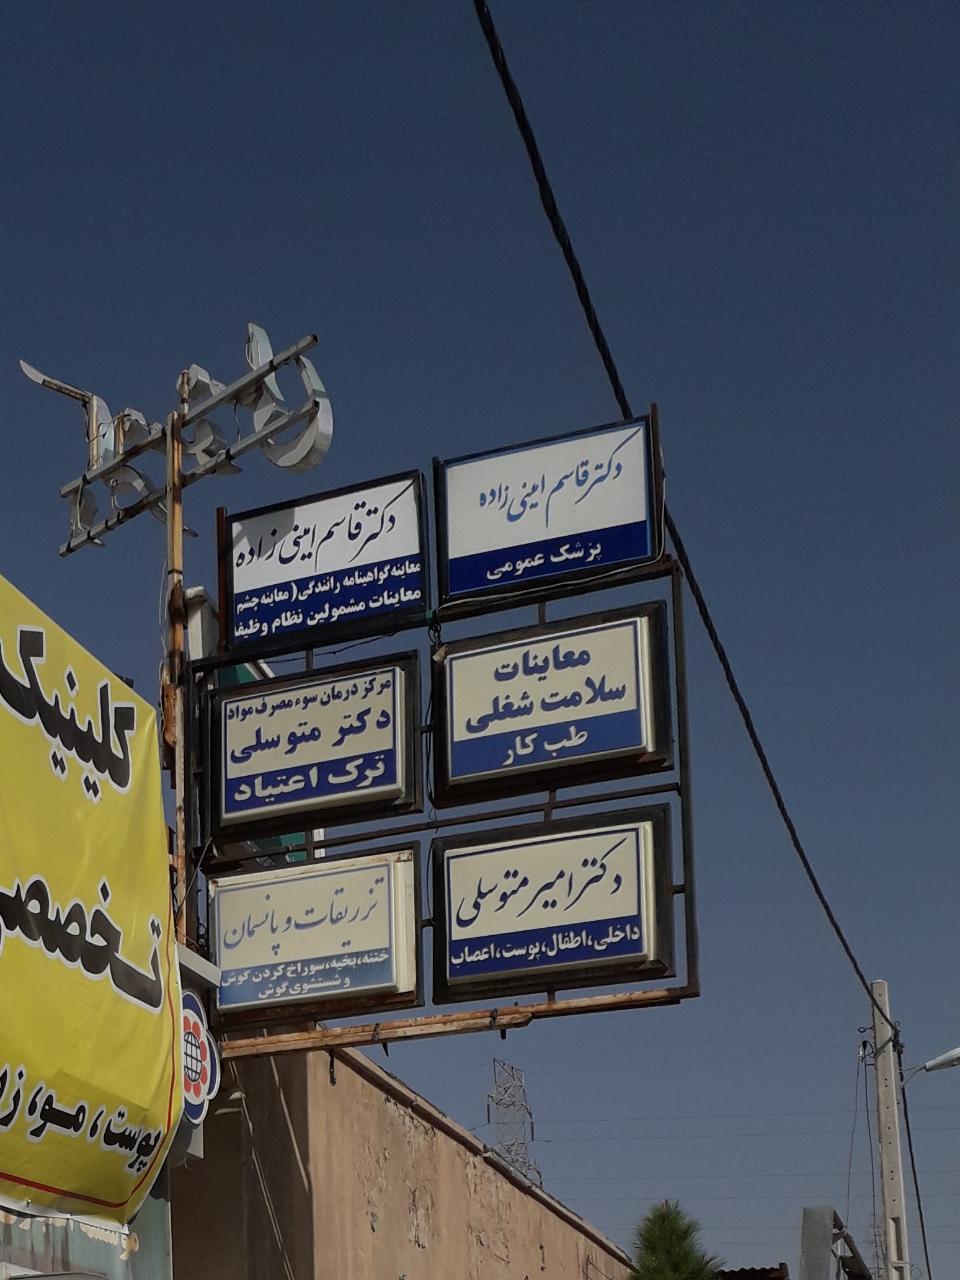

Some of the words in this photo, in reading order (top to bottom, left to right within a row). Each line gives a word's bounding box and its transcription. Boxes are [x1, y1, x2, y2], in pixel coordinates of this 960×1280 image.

[574, 428, 642, 505] دکتر
[479, 482, 510, 510] زاده
[506, 474, 546, 523] امینی
[546, 460, 590, 528] قاسم
[315, 500, 366, 573] قاسم
[349, 478, 418, 563] دکتر
[235, 528, 278, 568] زاده
[278, 522, 317, 565] امینی
[550, 542, 602, 563] پزشک
[342, 565, 391, 592] گواهینامه
[390, 559, 422, 579] معاینه
[486, 552, 545, 580] عمومی
[306, 601, 366, 627] مشمولین
[368, 588, 422, 609] معاینات
[271, 611, 304, 634] نظام
[493, 644, 591, 682] معاینات
[295, 692, 318, 710] سوء
[320, 683, 359, 706] درمان
[362, 677, 392, 696] مرکز
[540, 675, 626, 712] سلامت
[227, 704, 254, 721] مواد
[255, 697, 294, 717] مصرف
[465, 689, 534, 734] شغلی
[230, 721, 322, 764] متوسلی
[332, 707, 391, 747] دکتر
[543, 725, 589, 757] طب
[502, 732, 539, 766] کار
[233, 766, 319, 802] اعتیاد
[327, 754, 385, 788] ترک
[564, 837, 627, 911] دکتر
[455, 869, 529, 928] متوسلی
[516, 869, 574, 918] امیر
[223, 893, 281, 957] پانسمان
[294, 876, 386, 949] تزریقات
[451, 944, 495, 968] اعصاب
